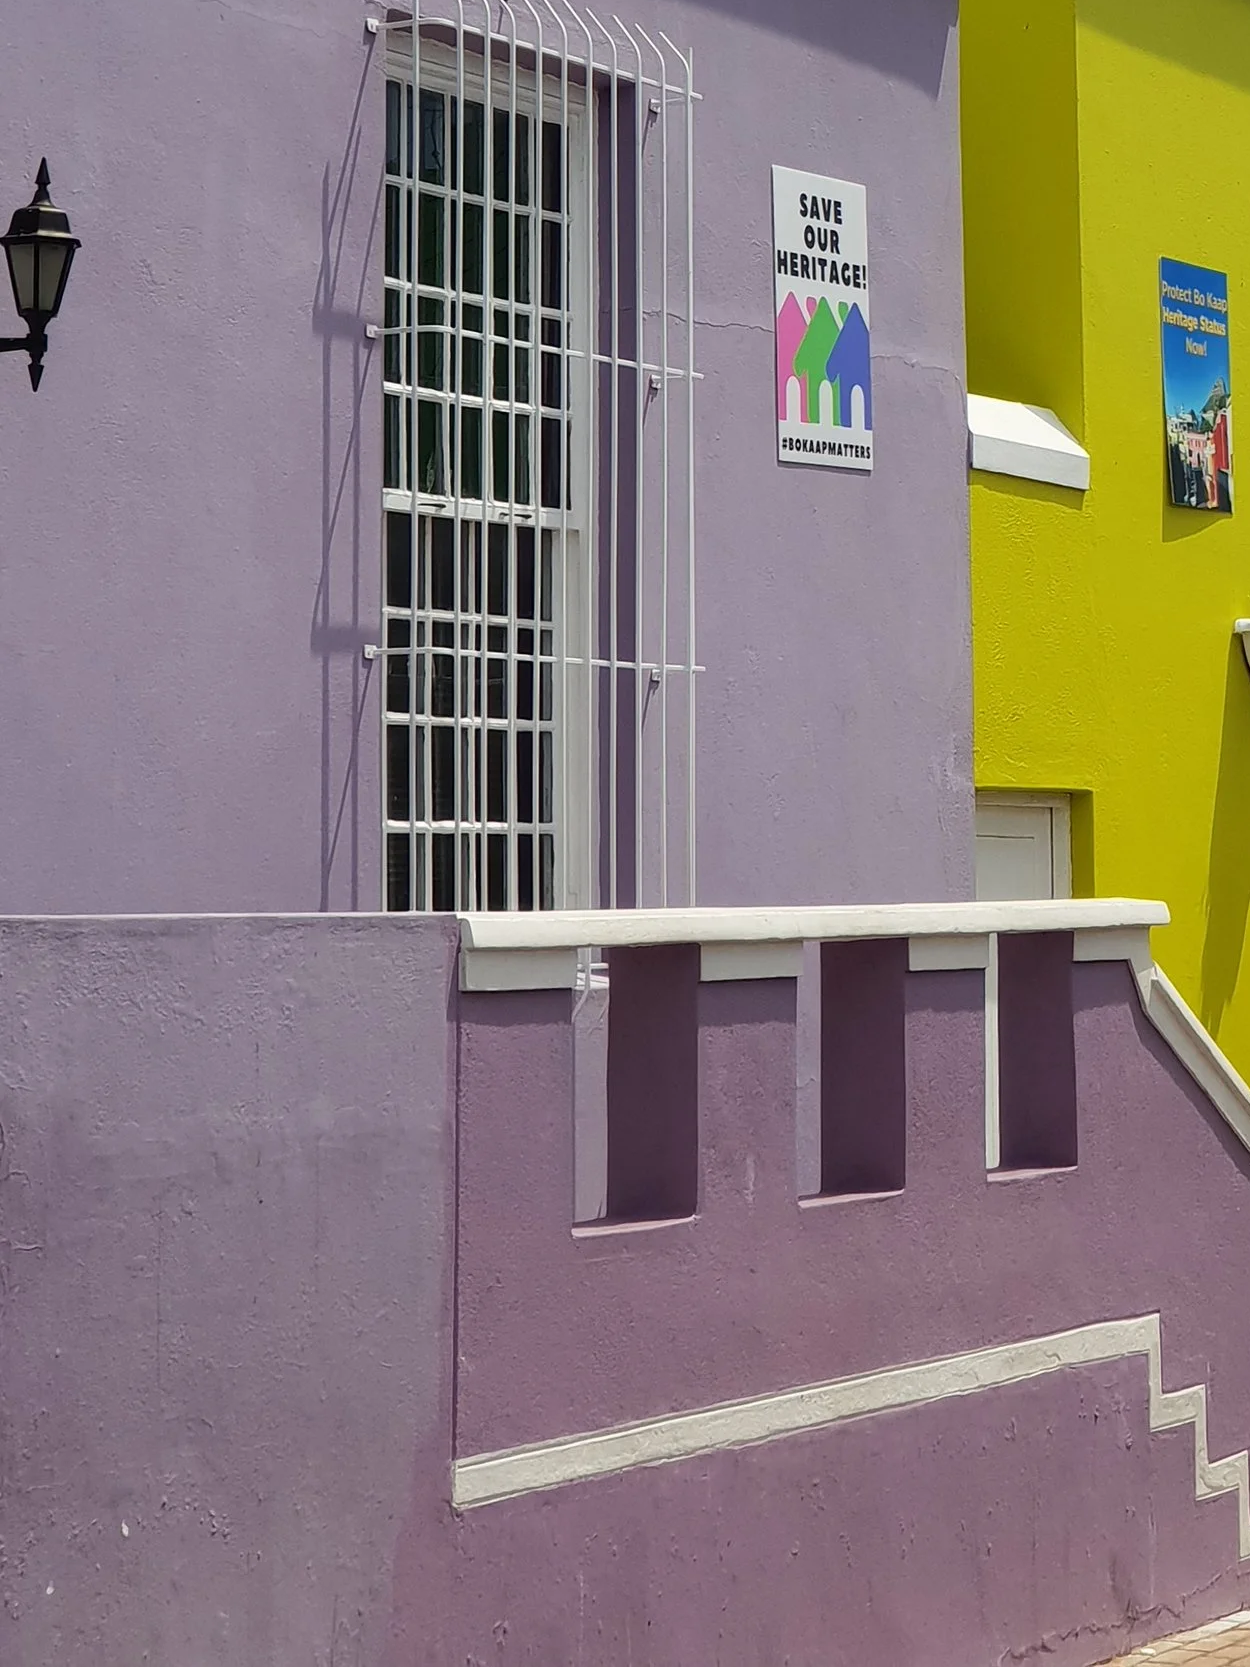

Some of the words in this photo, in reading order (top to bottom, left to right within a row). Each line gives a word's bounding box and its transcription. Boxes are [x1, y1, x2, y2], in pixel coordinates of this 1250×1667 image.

[800, 193, 842, 225] SAVE
[804, 225, 840, 254] OUR
[777, 250, 866, 290] HERITAGE!
[1162, 281, 1192, 303] Protect
[1193, 288, 1205, 306] Bo
[1206, 292, 1227, 314] Kaap
[1162, 306, 1198, 332] Heritage
[1199, 315, 1226, 336] Status
[1185, 337, 1207, 356] Now!
[782, 437, 870, 460] #BOKAAPMATTERS
